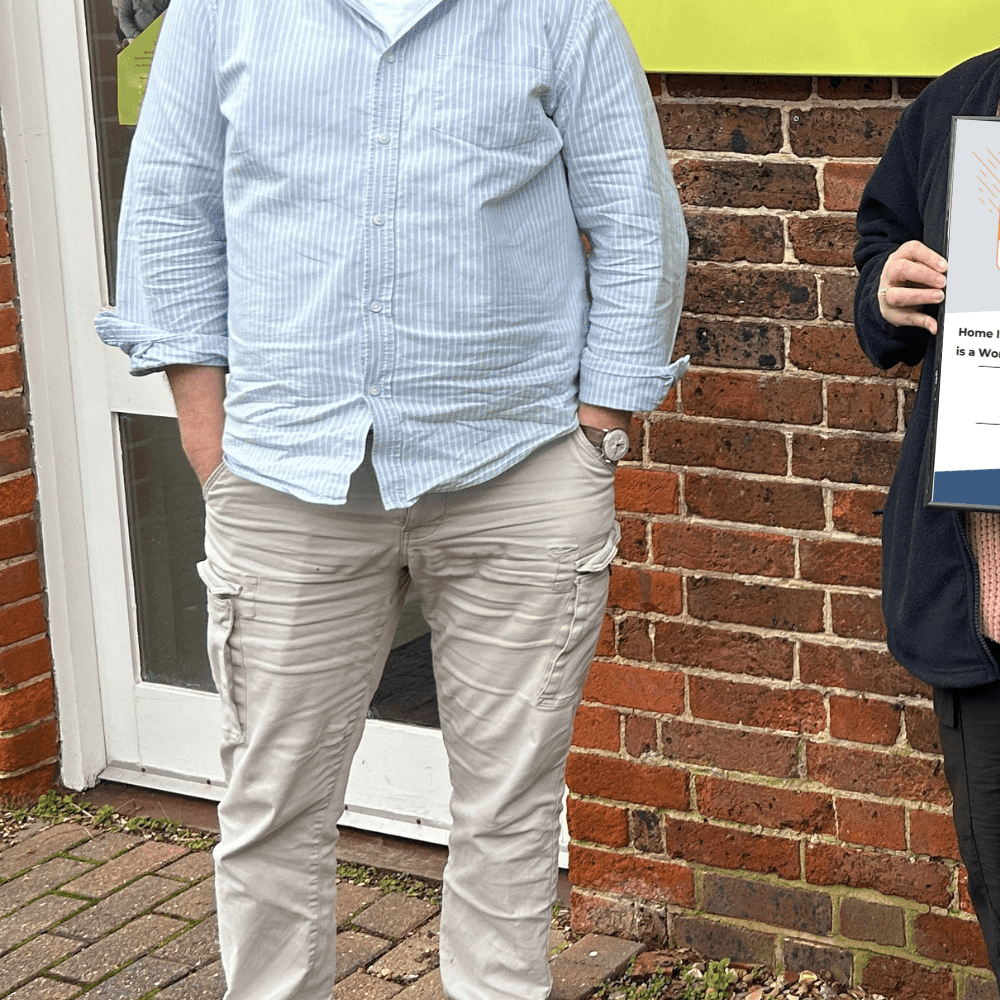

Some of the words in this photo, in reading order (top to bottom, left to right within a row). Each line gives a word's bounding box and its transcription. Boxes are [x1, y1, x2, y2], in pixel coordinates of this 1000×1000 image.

[958, 327, 993, 339] Home
[956, 346, 966, 357] is
[968, 349, 976, 357] a
